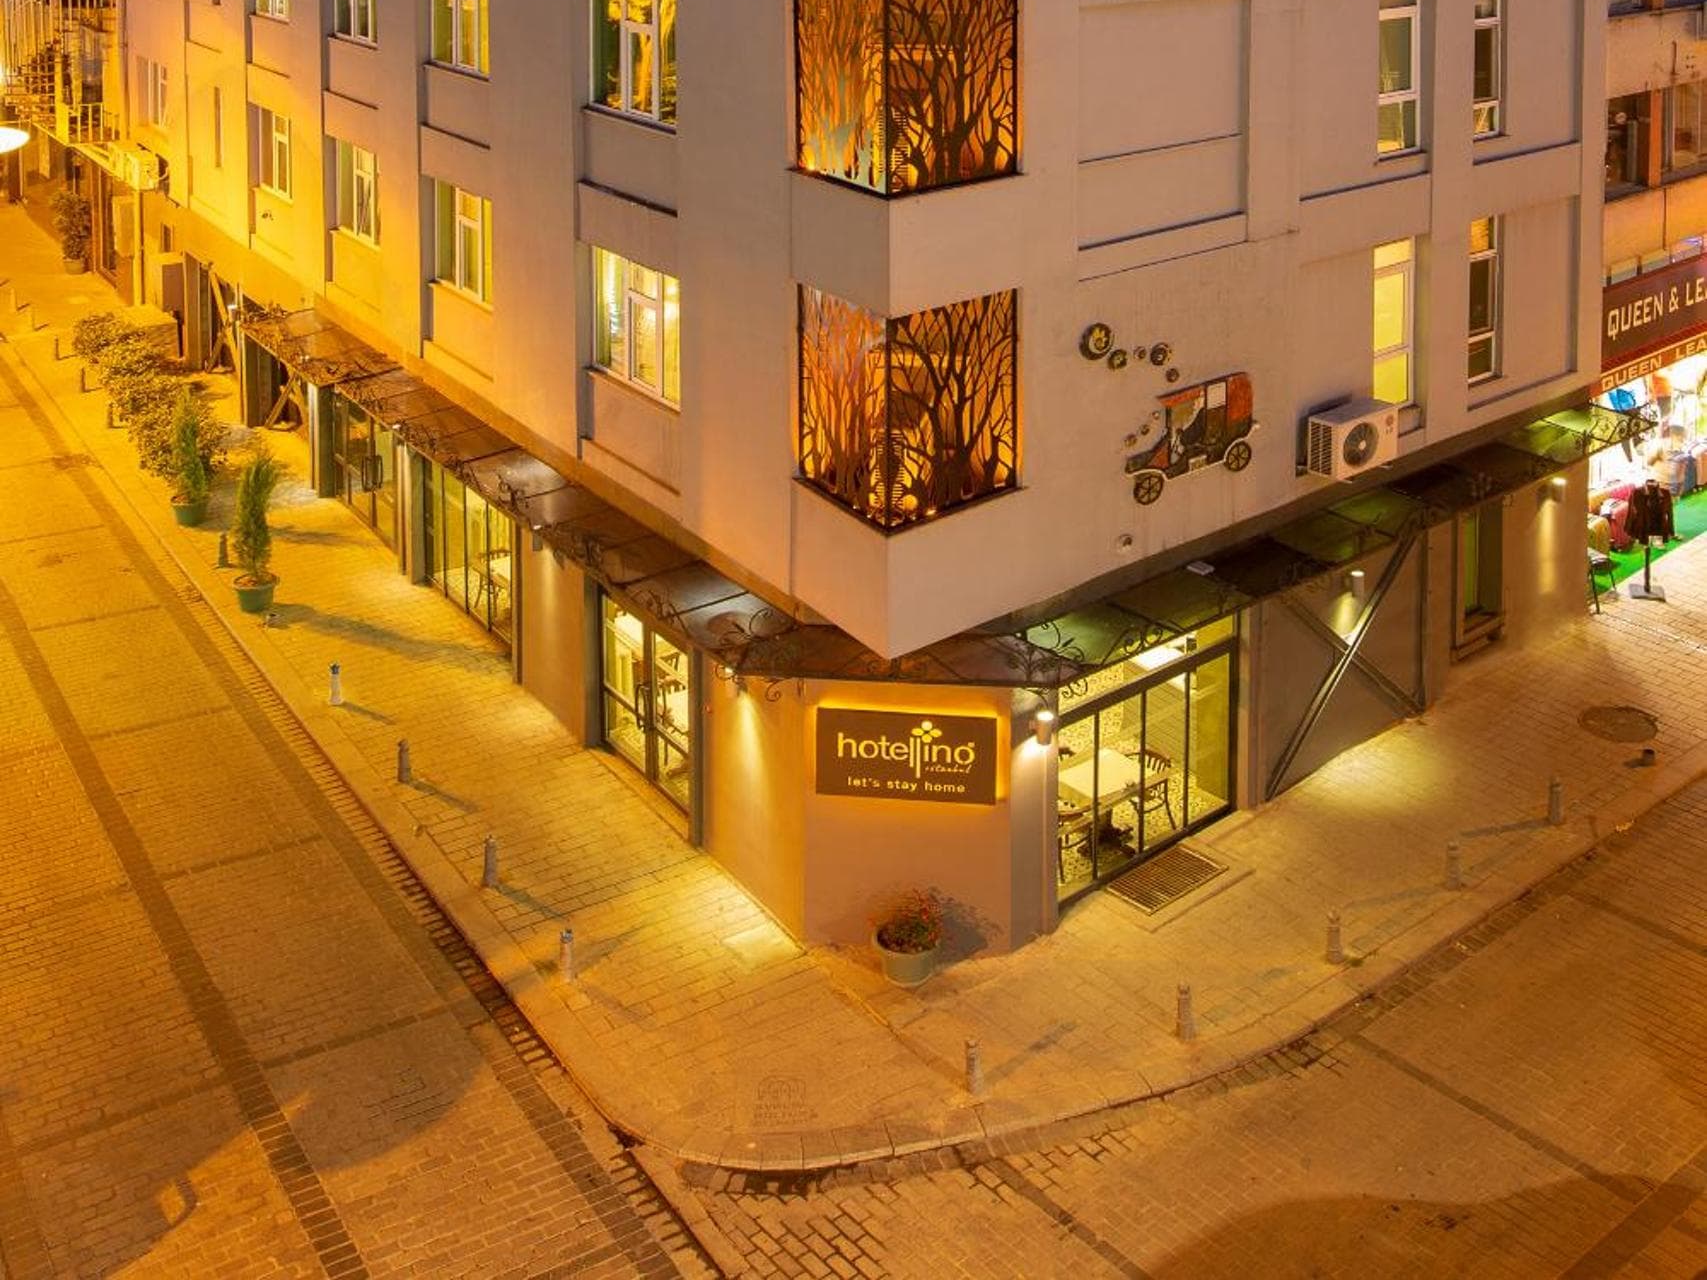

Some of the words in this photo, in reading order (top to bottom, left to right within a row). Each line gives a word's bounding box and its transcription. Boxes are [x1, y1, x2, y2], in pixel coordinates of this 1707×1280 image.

[1607, 294, 1664, 341] QUEEN
[1669, 286, 1679, 313] &
[1685, 277, 1707, 307] LE
[1602, 355, 1662, 392] QUEEN
[848, 776, 880, 789] let's
[887, 781, 918, 791] stay
[925, 781, 966, 792] home
